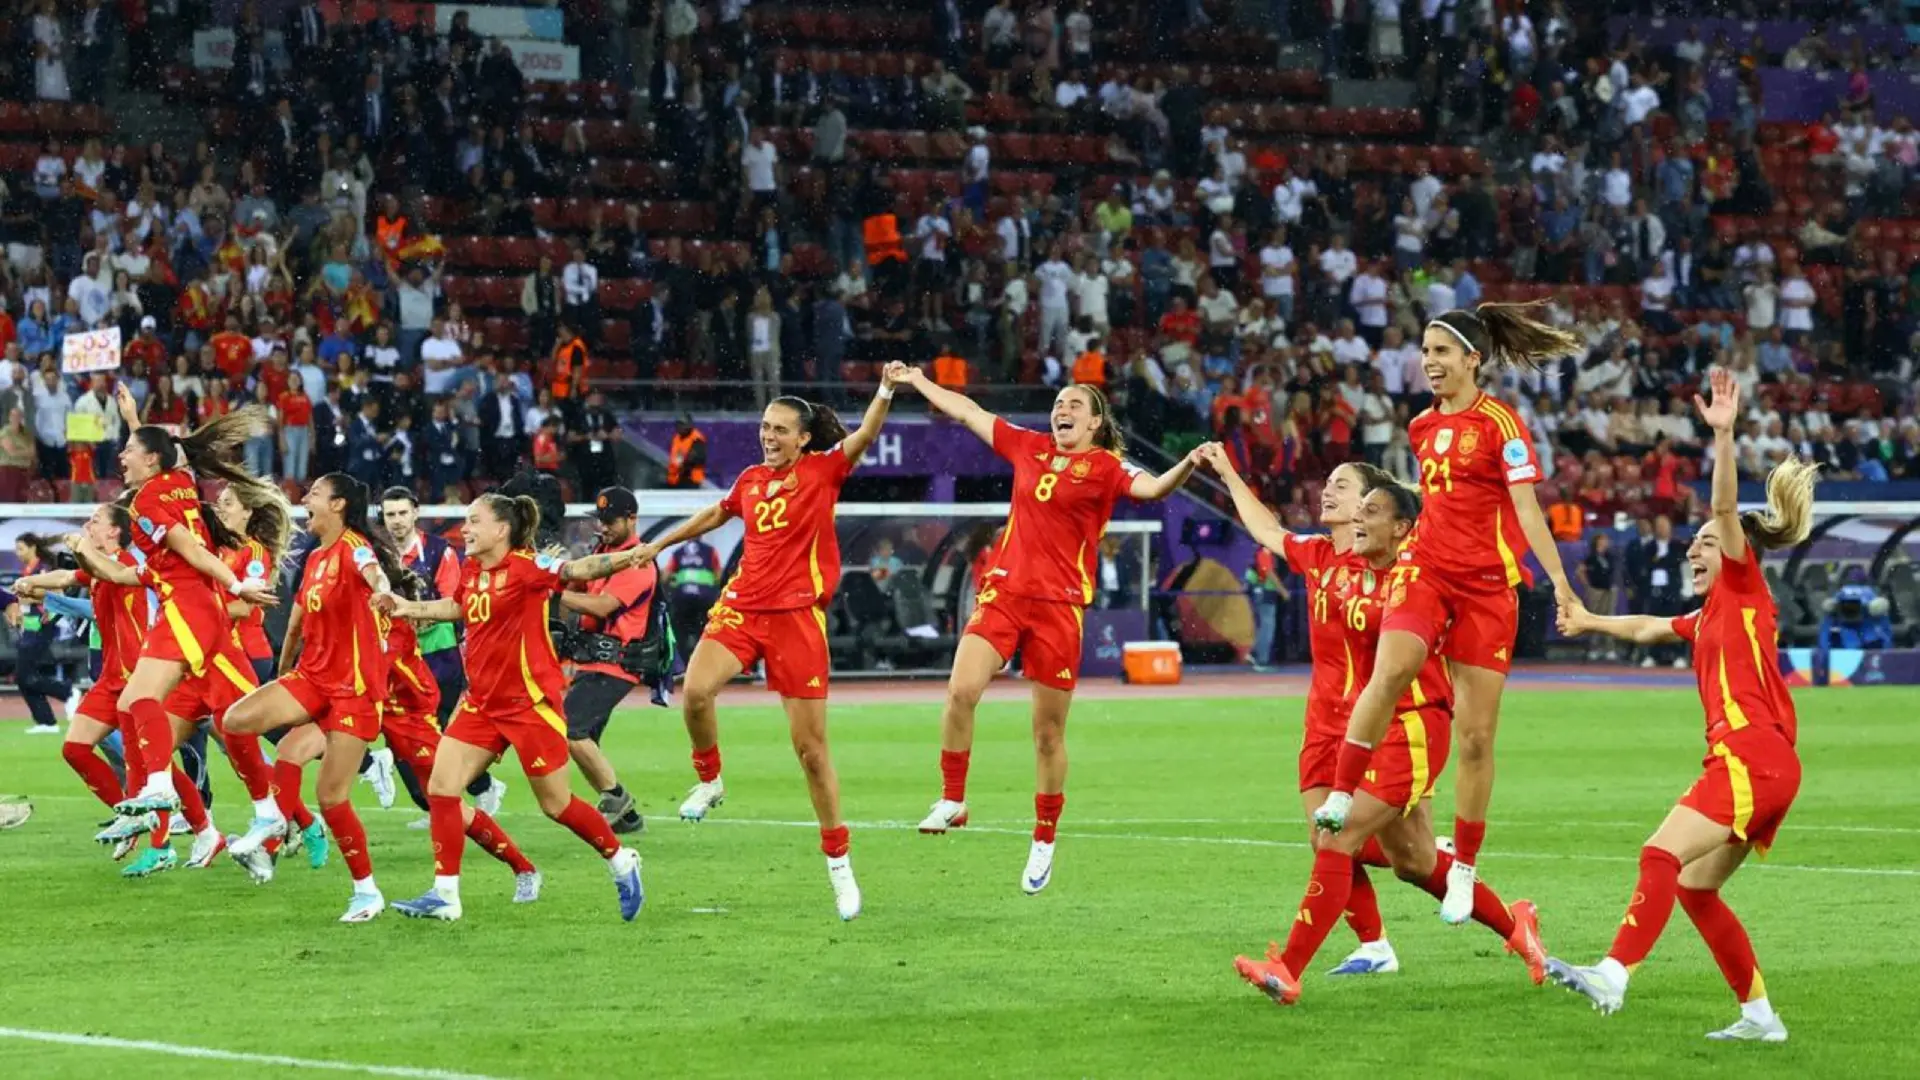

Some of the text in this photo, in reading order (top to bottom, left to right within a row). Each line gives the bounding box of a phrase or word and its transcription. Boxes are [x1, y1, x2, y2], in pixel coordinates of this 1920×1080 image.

[521, 52, 564, 70] 2025
[1035, 473, 1058, 502] 8
[1422, 457, 1453, 495] 21
[755, 497, 789, 533] 22
[306, 583, 322, 613] 15
[467, 591, 490, 623] 20
[1314, 587, 1328, 625] 11
[1346, 594, 1372, 632] 16
